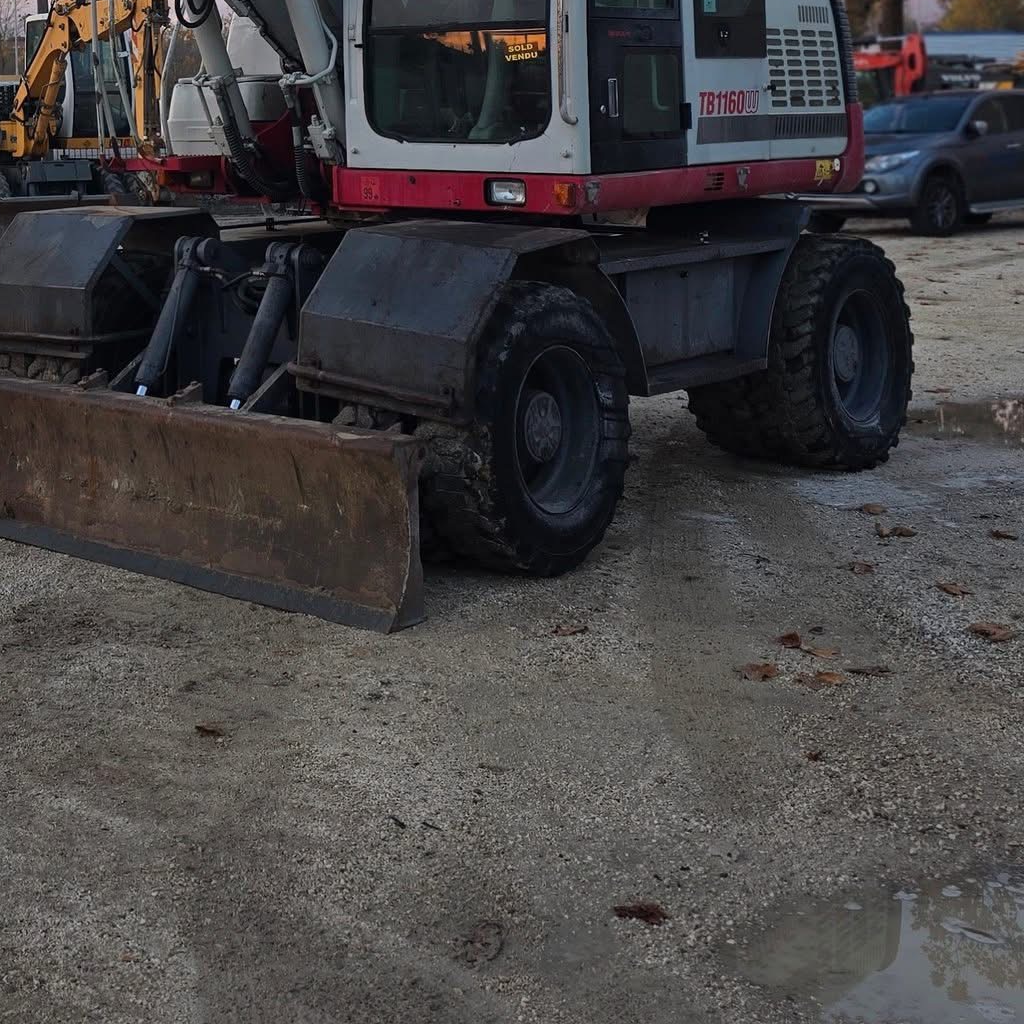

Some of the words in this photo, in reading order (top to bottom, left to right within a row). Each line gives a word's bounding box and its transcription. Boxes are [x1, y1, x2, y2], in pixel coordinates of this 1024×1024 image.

[508, 43, 533, 53] SOLD
[505, 51, 538, 62] VENDU
[699, 90, 759, 116] TB1160W
